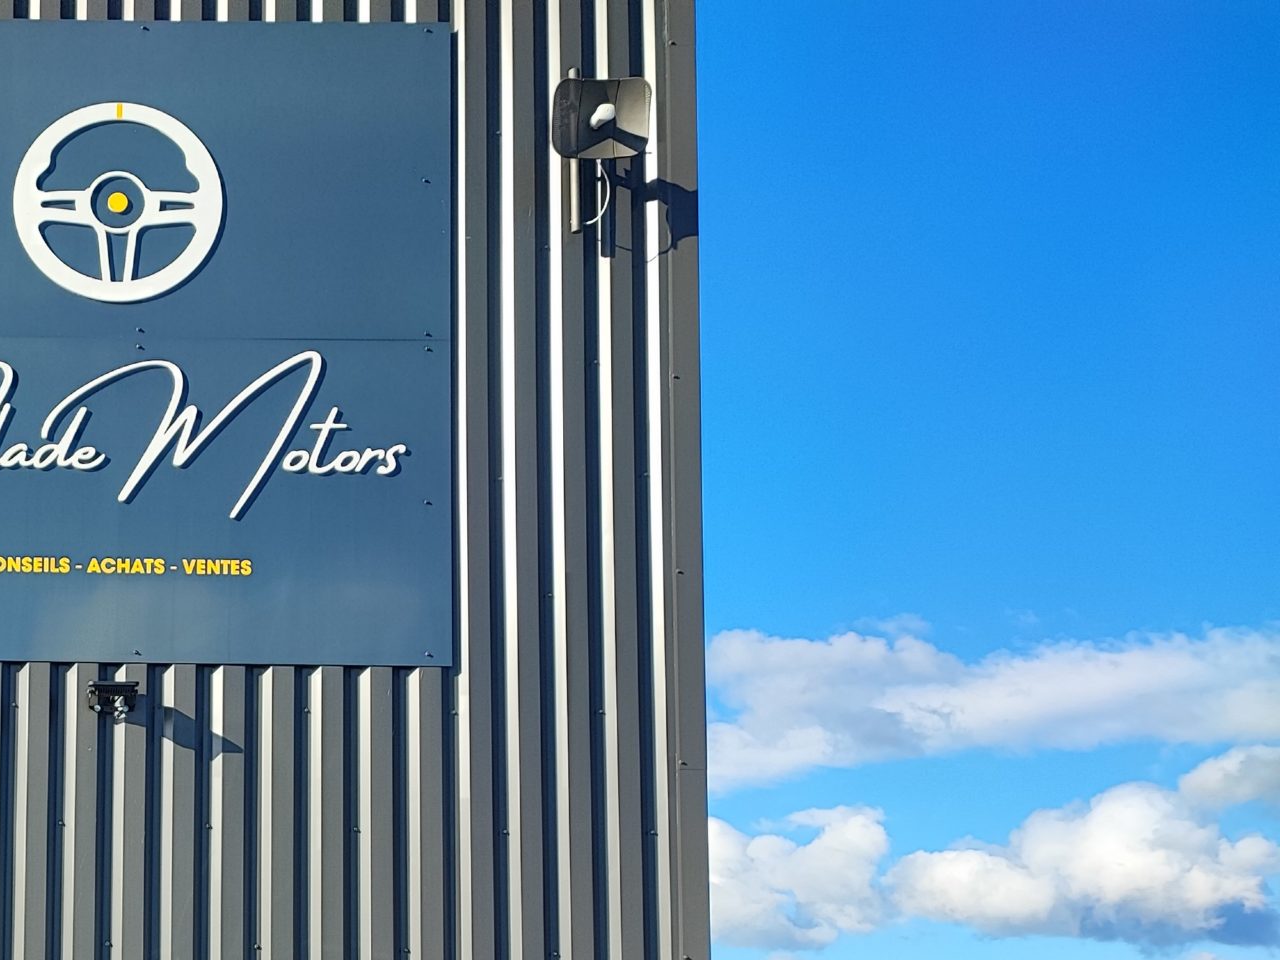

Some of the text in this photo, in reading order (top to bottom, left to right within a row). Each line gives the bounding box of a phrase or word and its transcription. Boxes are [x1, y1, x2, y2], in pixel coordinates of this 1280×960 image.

[41, 350, 407, 519] Motors
[87, 557, 166, 575] ACHATS
[182, 558, 253, 576] VENTES
